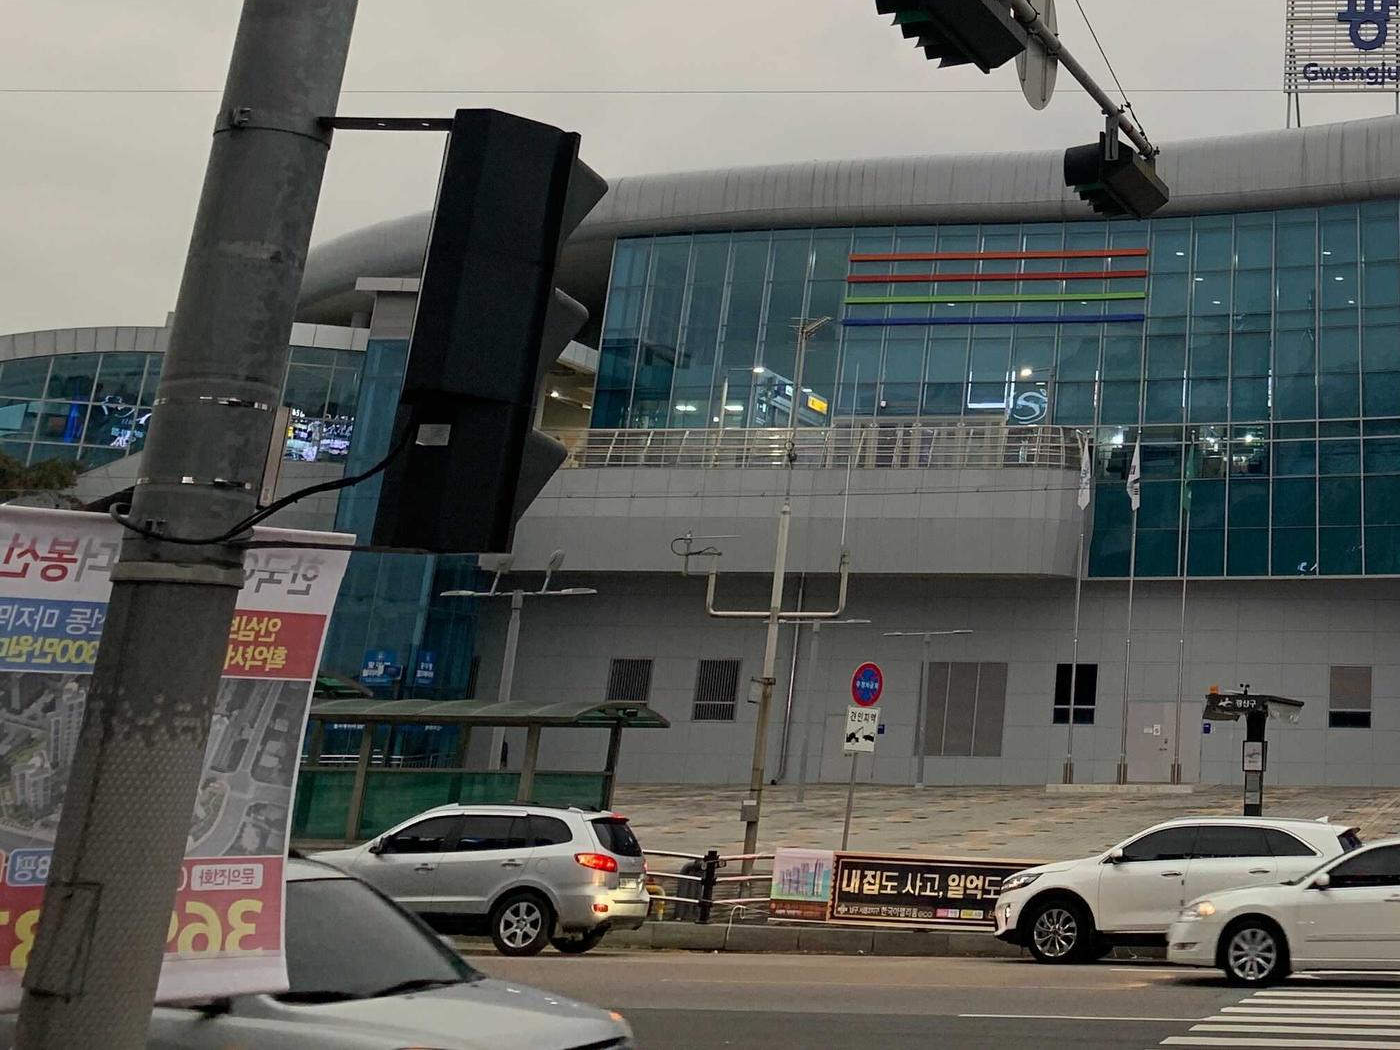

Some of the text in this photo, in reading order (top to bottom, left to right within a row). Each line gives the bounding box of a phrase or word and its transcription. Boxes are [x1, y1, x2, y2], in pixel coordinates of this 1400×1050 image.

[850, 711, 877, 723] 견인지역
[841, 869, 1002, 900] 내집도 사고, 일억도
